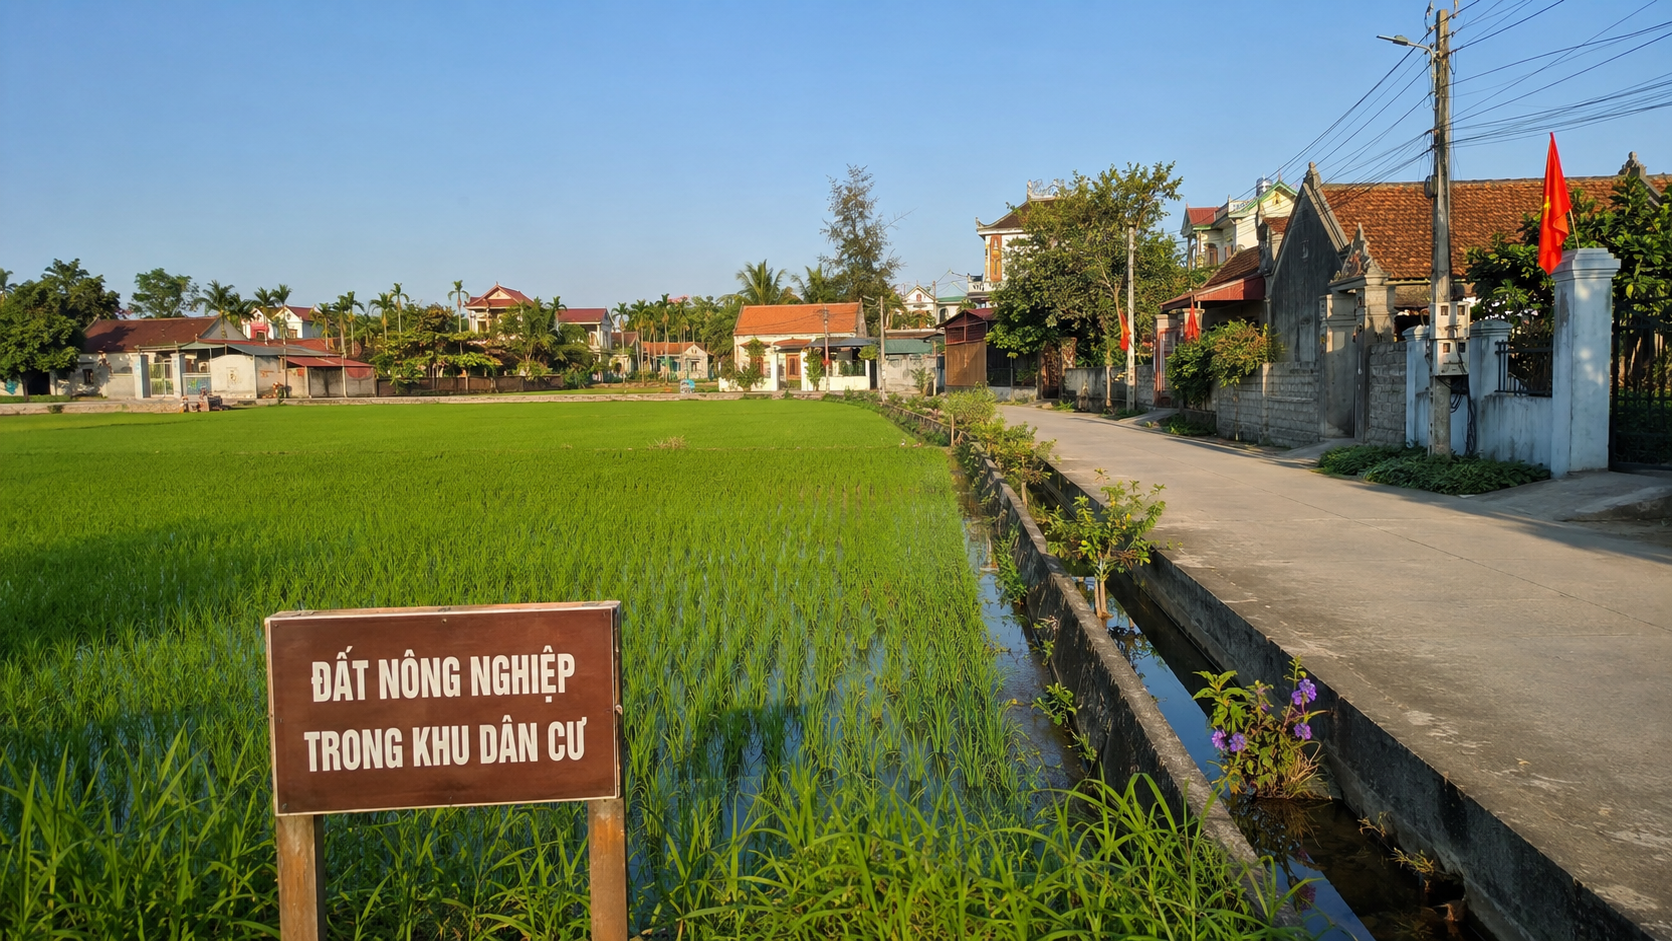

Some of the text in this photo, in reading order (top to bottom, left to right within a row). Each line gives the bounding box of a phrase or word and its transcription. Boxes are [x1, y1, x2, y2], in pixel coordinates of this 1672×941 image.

[310, 645, 576, 704] ĐẤT NÔNG NGHIỆP
[303, 714, 588, 773] TRONG KHU DÂN CƯ
